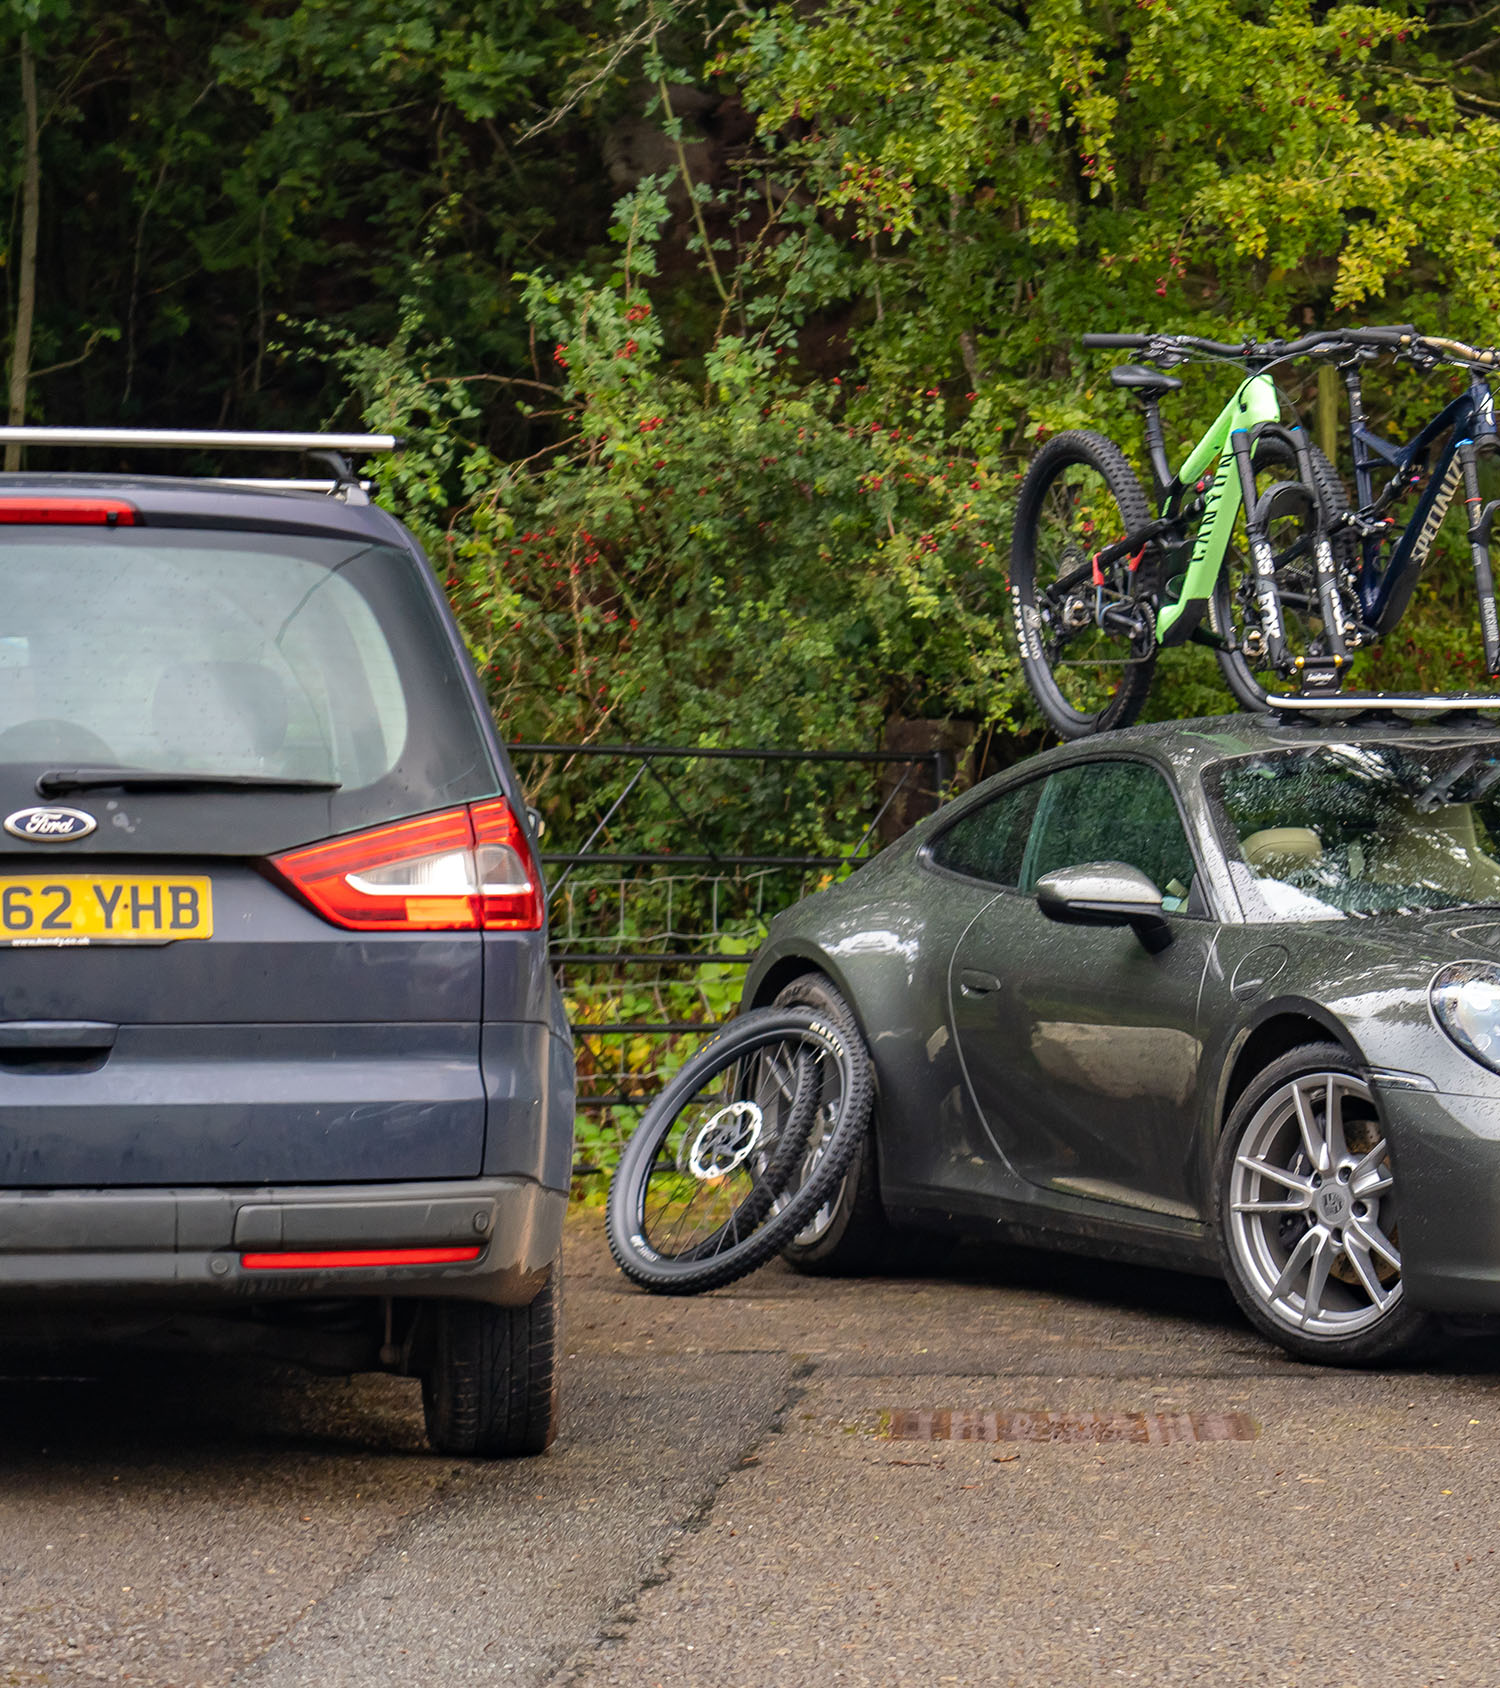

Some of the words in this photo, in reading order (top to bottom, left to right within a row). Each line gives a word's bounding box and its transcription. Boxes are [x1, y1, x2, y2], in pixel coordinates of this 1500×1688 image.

[1191, 451, 1233, 562] CANYON
[25, 813, 75, 834] Ford
[2, 885, 72, 930] 62
[92, 885, 200, 929] YHB
[809, 1021, 844, 1057] MAXXIS
